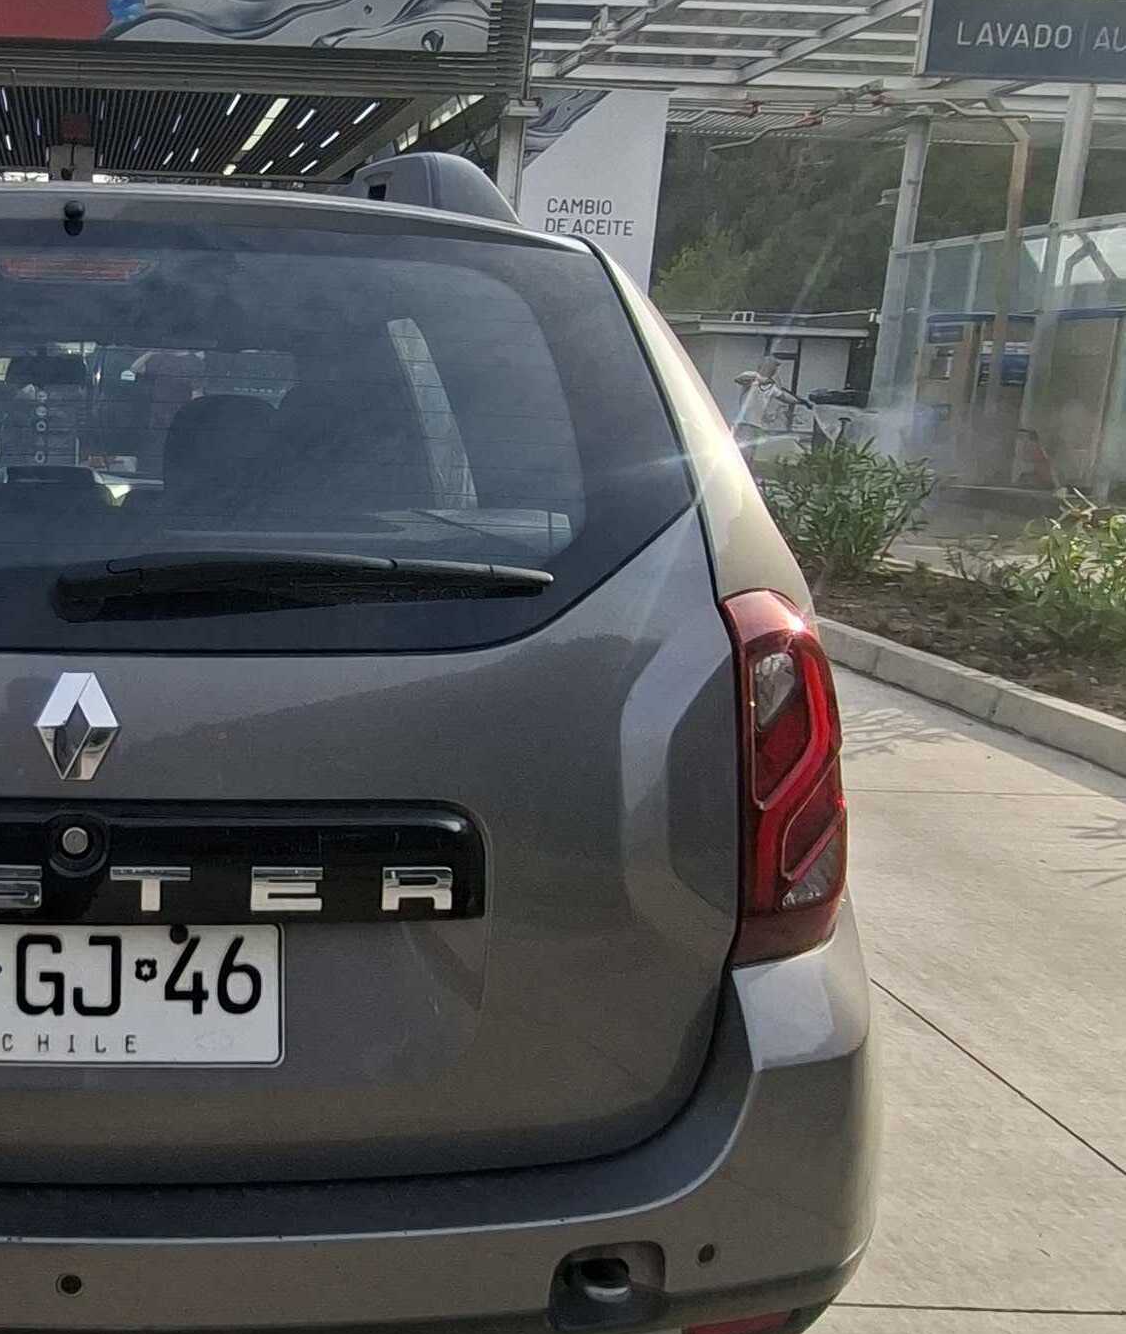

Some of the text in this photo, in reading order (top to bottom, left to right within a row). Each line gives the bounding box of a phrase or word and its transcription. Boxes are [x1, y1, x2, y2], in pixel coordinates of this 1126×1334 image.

[956, 21, 1072, 49] LAVADO
[547, 198, 612, 215] CAMBIO
[544, 217, 634, 236] DE ACEITE
[1, 1033, 137, 1054] CHILE
